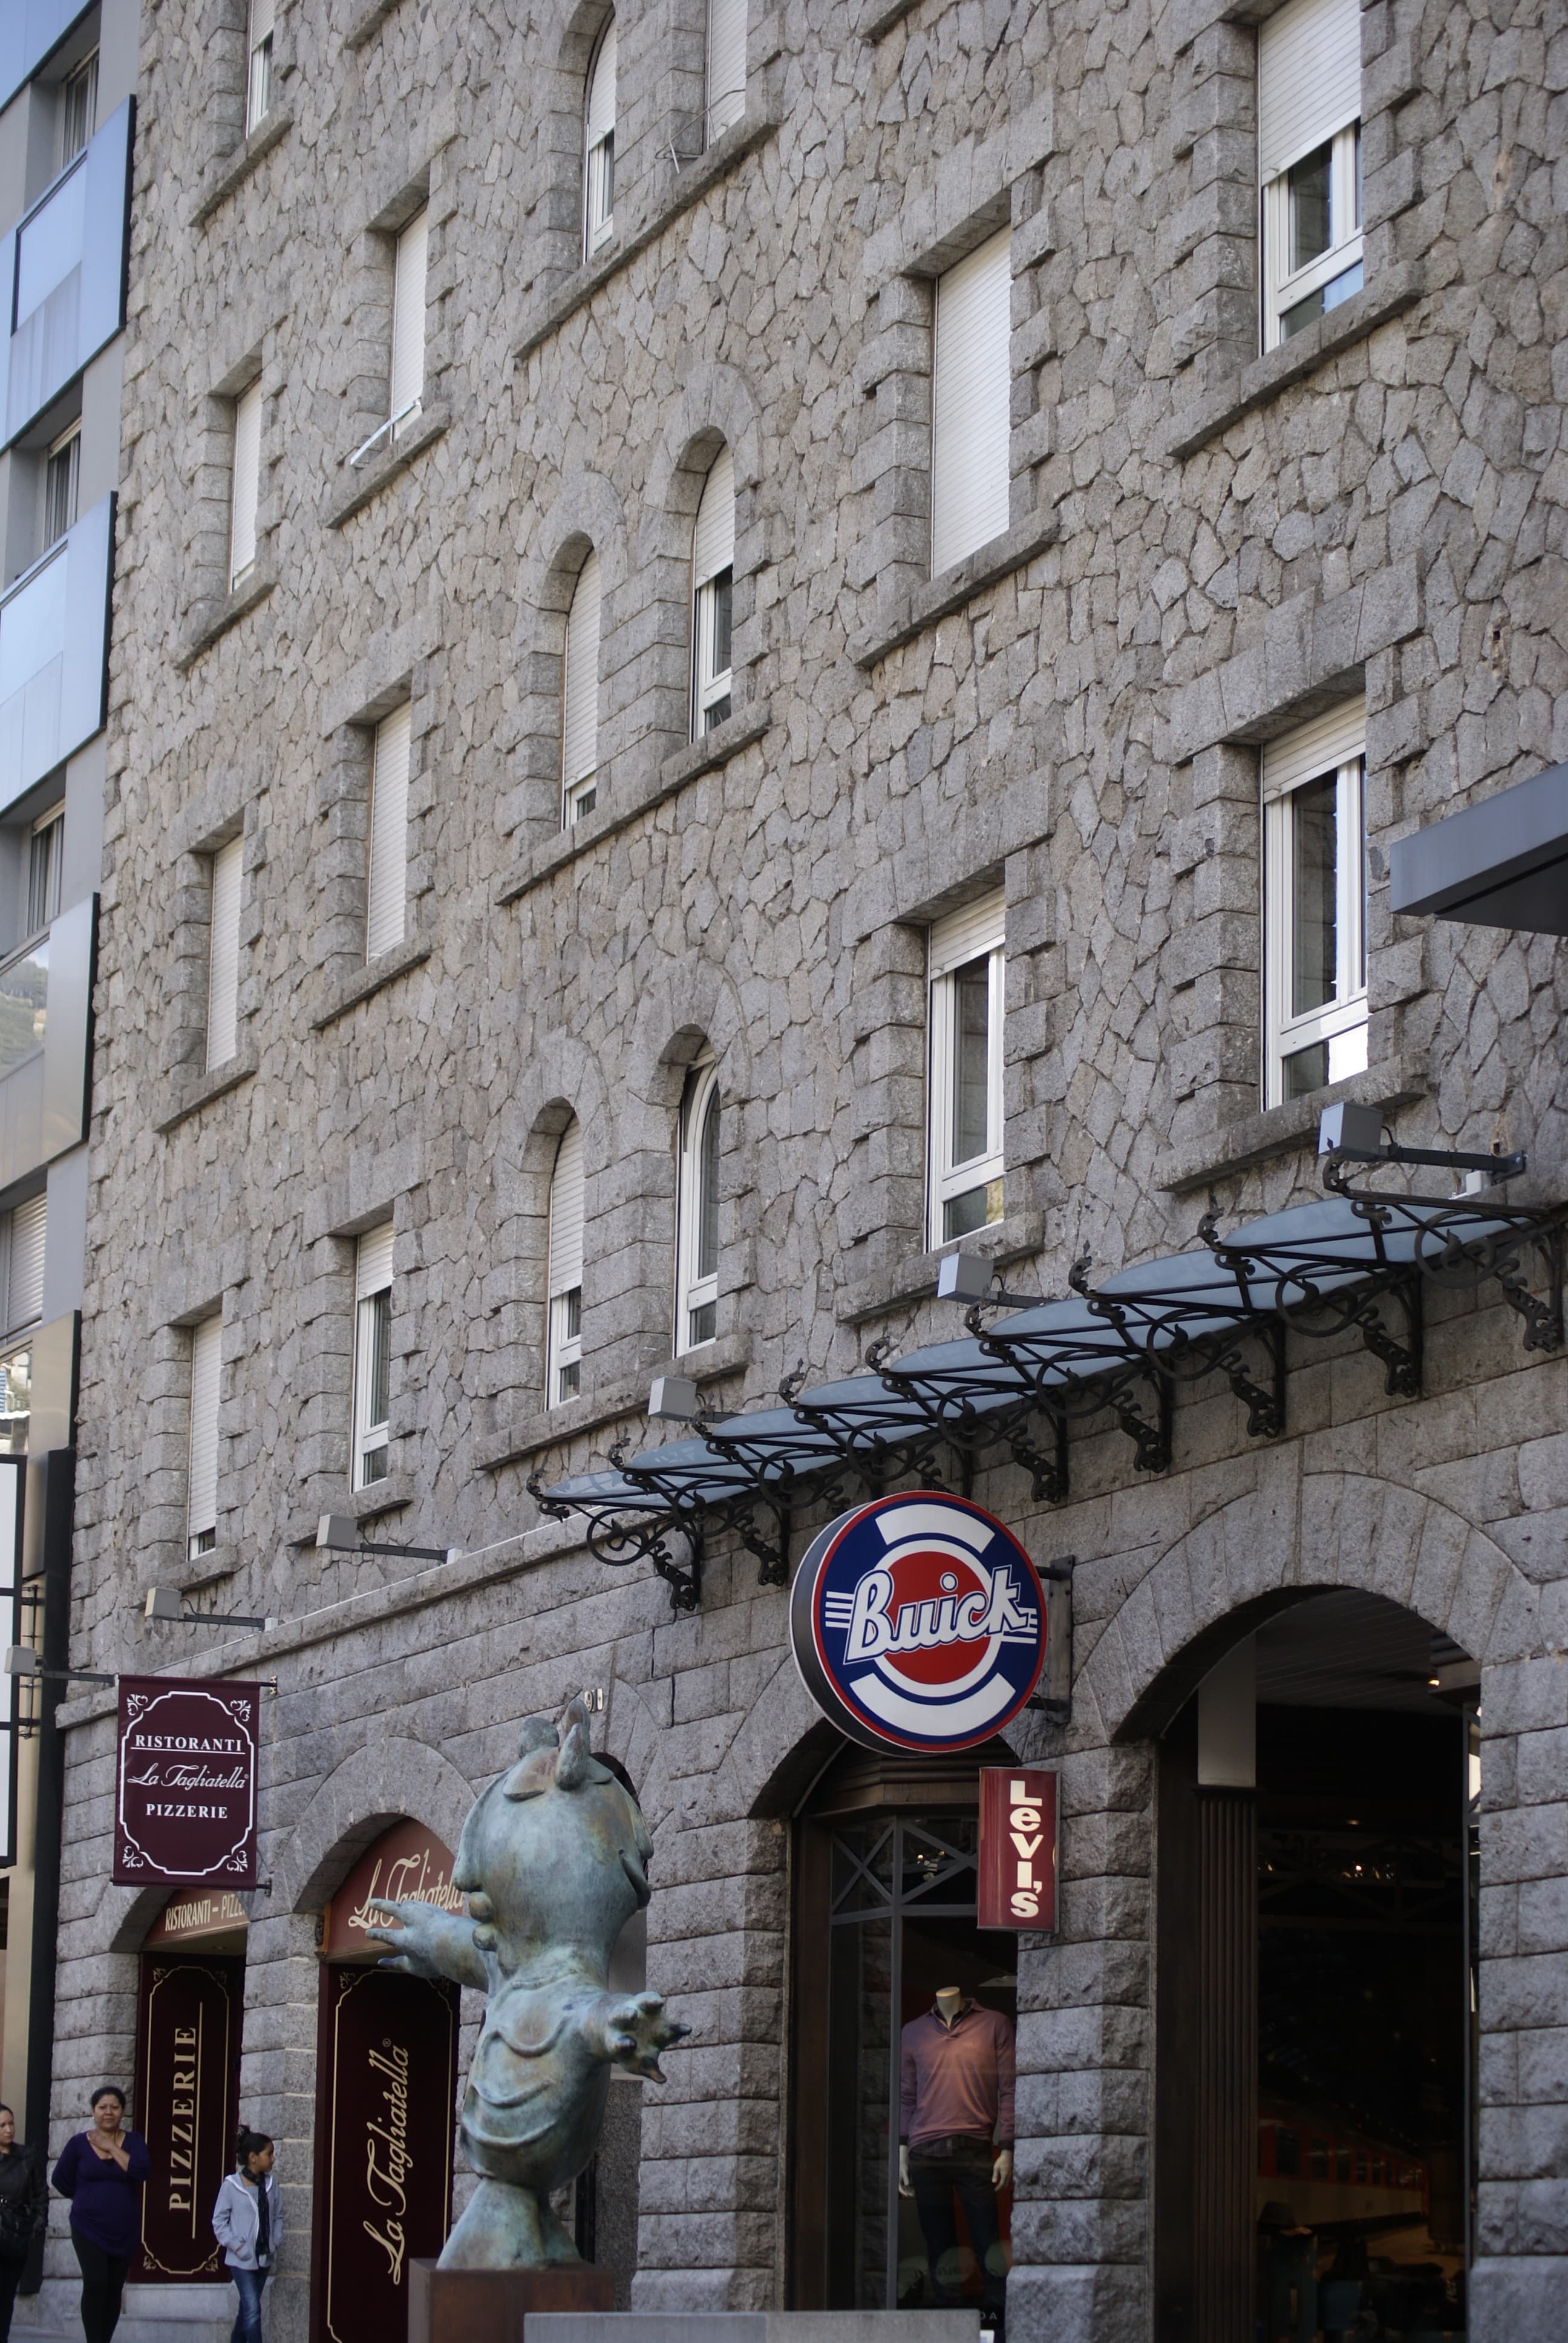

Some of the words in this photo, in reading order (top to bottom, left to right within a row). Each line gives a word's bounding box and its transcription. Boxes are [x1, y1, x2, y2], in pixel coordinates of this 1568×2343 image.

[843, 1564, 1031, 1665] Buick
[135, 1734, 242, 1752] RISTORANTI
[127, 1762, 159, 1786] La
[146, 1803, 228, 1819] PIZZERIE
[165, 1899, 211, 1932] RISTORANTI
[169, 2027, 196, 2212] PIZZERIE
[363, 2220, 405, 2285] La
